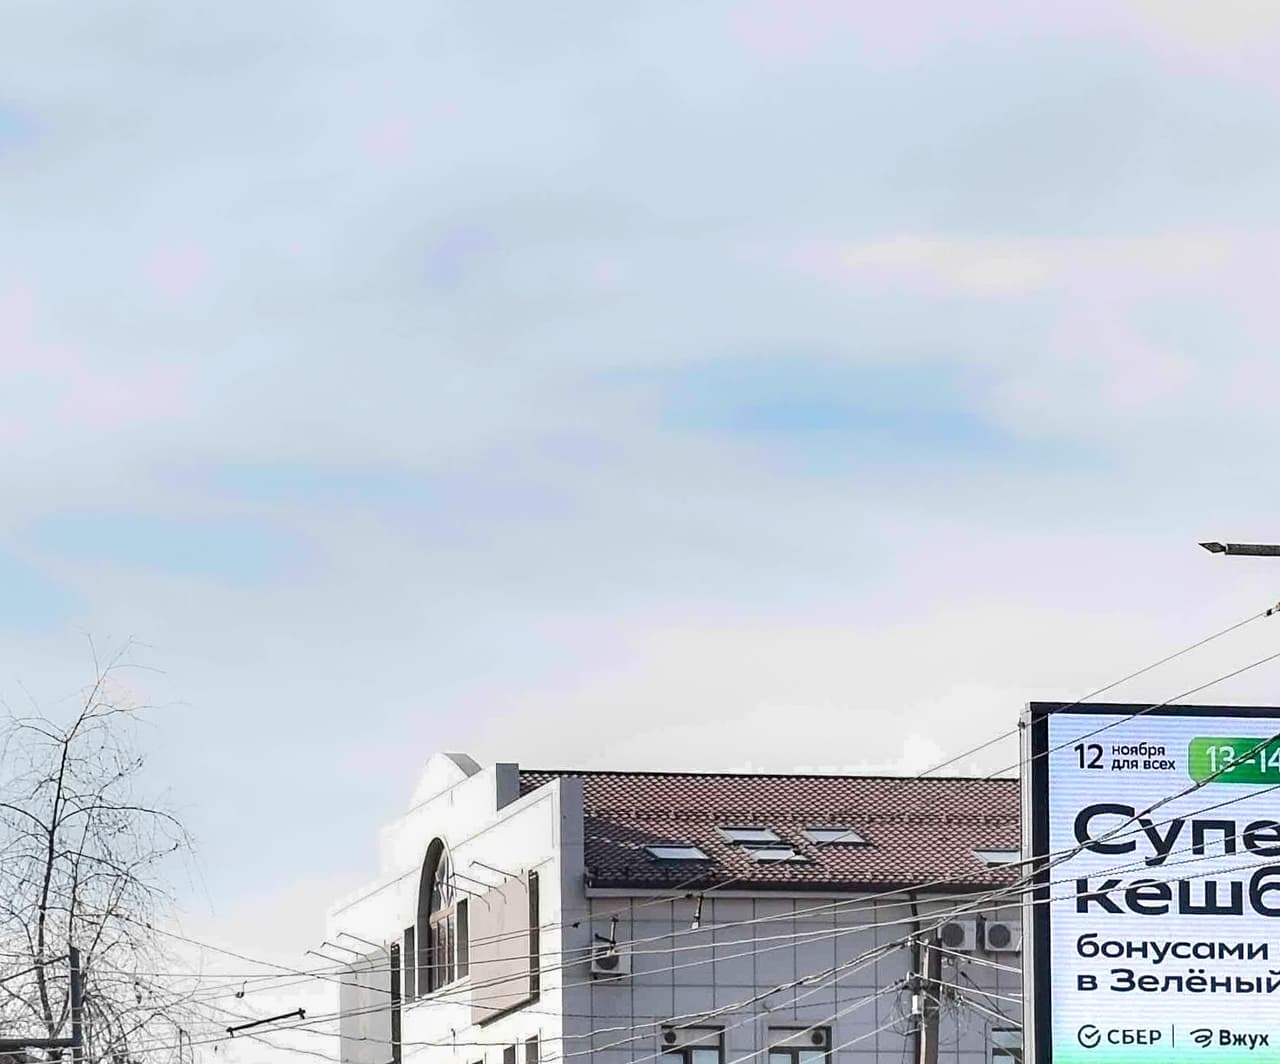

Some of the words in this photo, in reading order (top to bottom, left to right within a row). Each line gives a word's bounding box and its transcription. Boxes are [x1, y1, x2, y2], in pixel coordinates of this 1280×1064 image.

[1074, 742, 1104, 769] 12
[1112, 742, 1166, 757] ноября
[1111, 758, 1139, 771] для
[1144, 758, 1176, 770] всех
[1076, 933, 1269, 964] бонусами
[1076, 973, 1098, 991] в
[1107, 1029, 1162, 1046] СБЕР
[1219, 1028, 1269, 1048] Вжух
